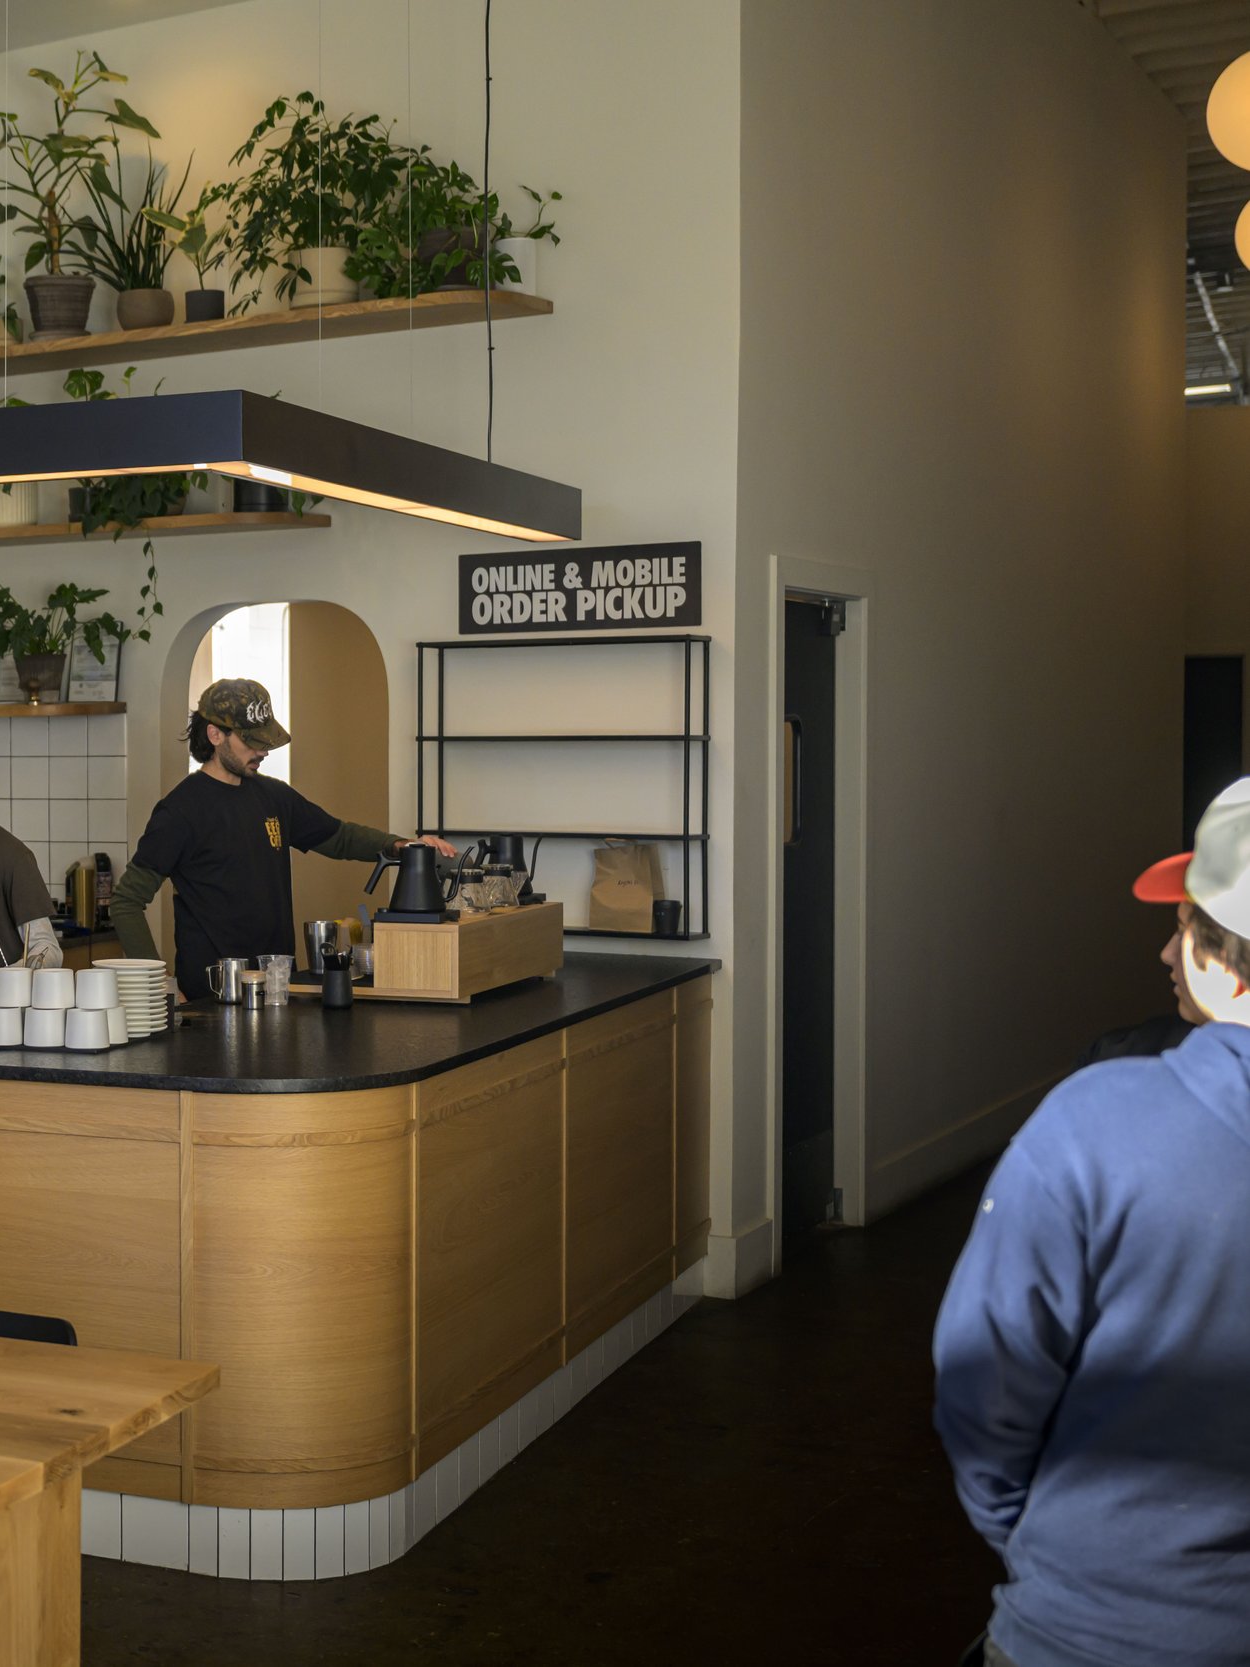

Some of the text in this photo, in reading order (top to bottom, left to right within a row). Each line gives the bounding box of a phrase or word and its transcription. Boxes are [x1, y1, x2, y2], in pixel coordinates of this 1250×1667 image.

[471, 556, 686, 593] ONLINE & MOBILE
[471, 585, 686, 625] ORDER PICKUP
